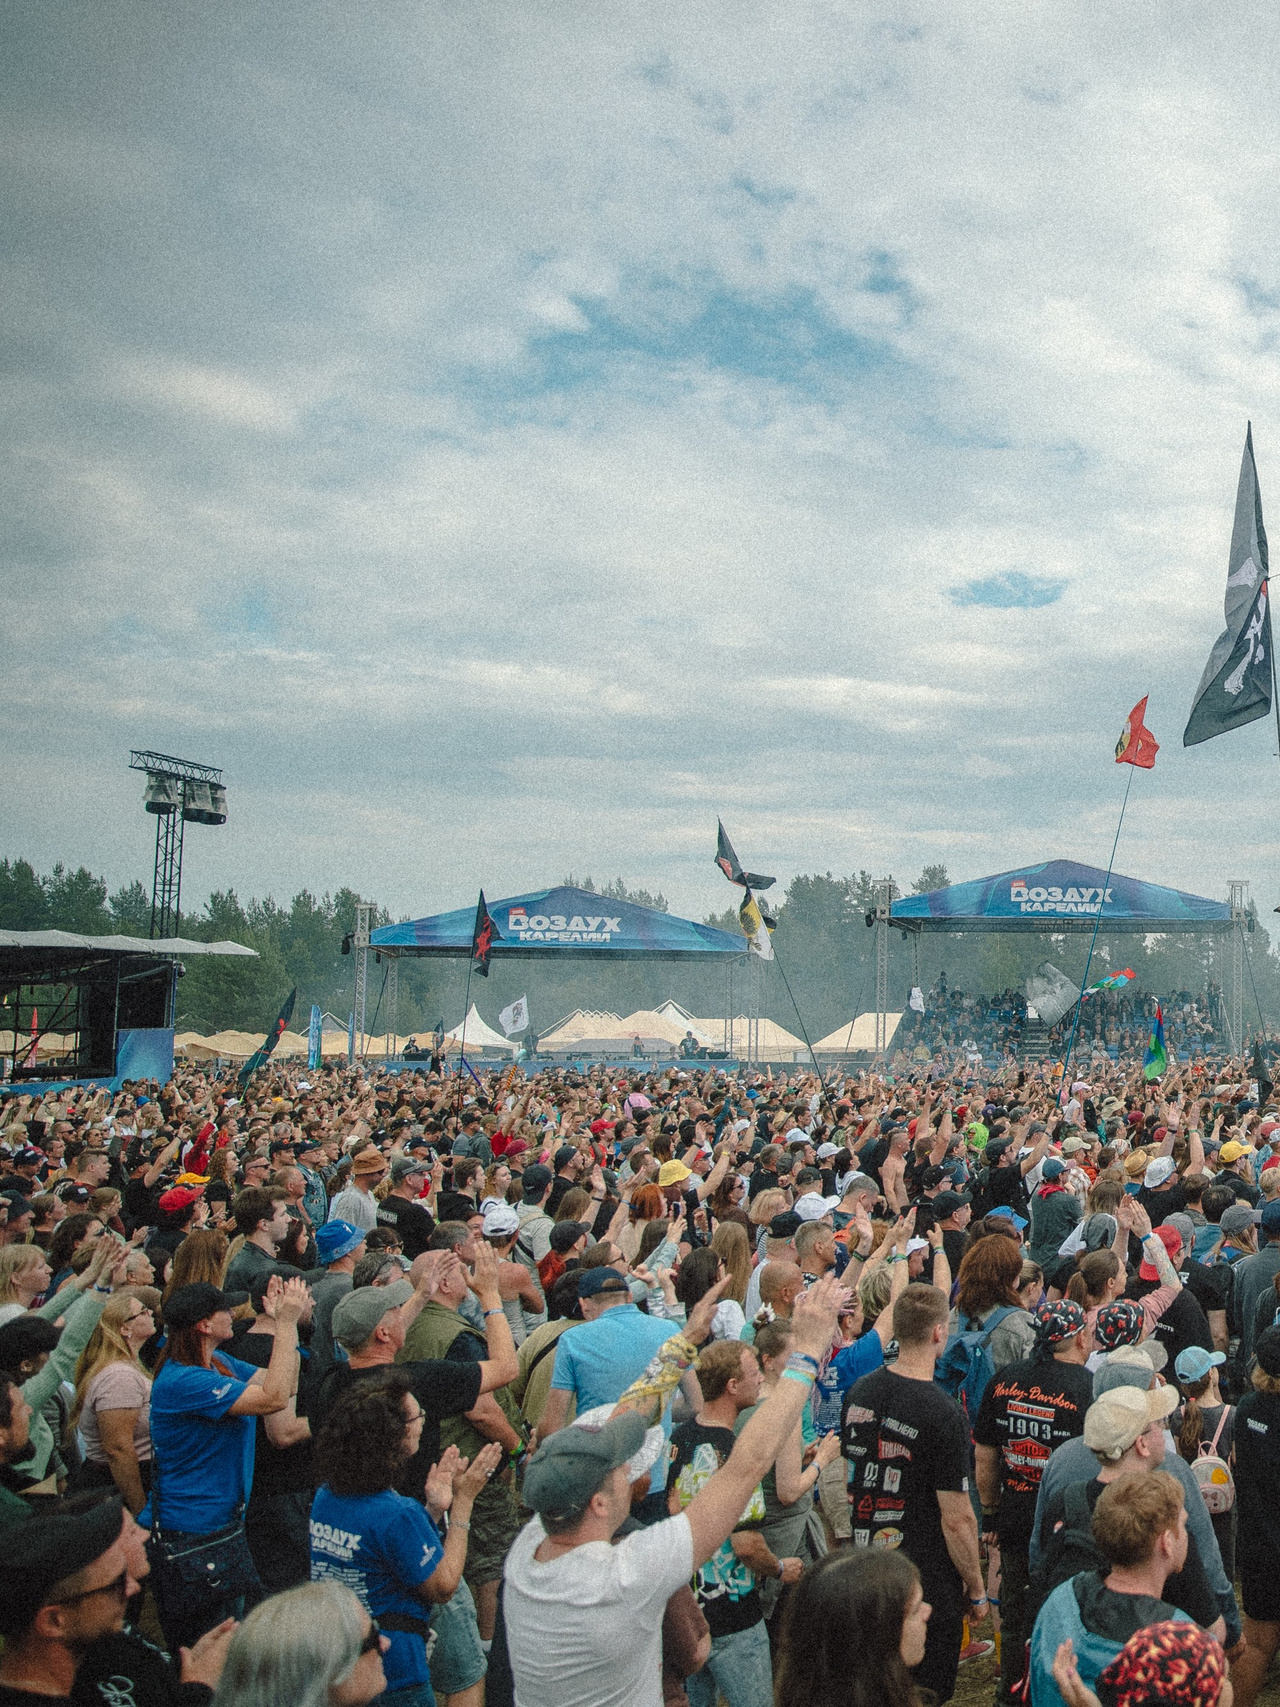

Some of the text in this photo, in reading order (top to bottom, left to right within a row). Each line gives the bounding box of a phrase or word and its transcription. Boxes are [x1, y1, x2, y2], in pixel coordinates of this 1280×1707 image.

[1011, 887, 1113, 903] ВОЗДУХ
[509, 915, 622, 932] ВОЗДУХ
[519, 931, 611, 942] КАРЕЛИИ
[993, 1382, 1078, 1411] Harley-Davidson
[1007, 1402, 1055, 1418] LIVING LEGEND
[1009, 1417, 1051, 1440] 1903
[311, 1537, 353, 1559] АРЕЛИИ
